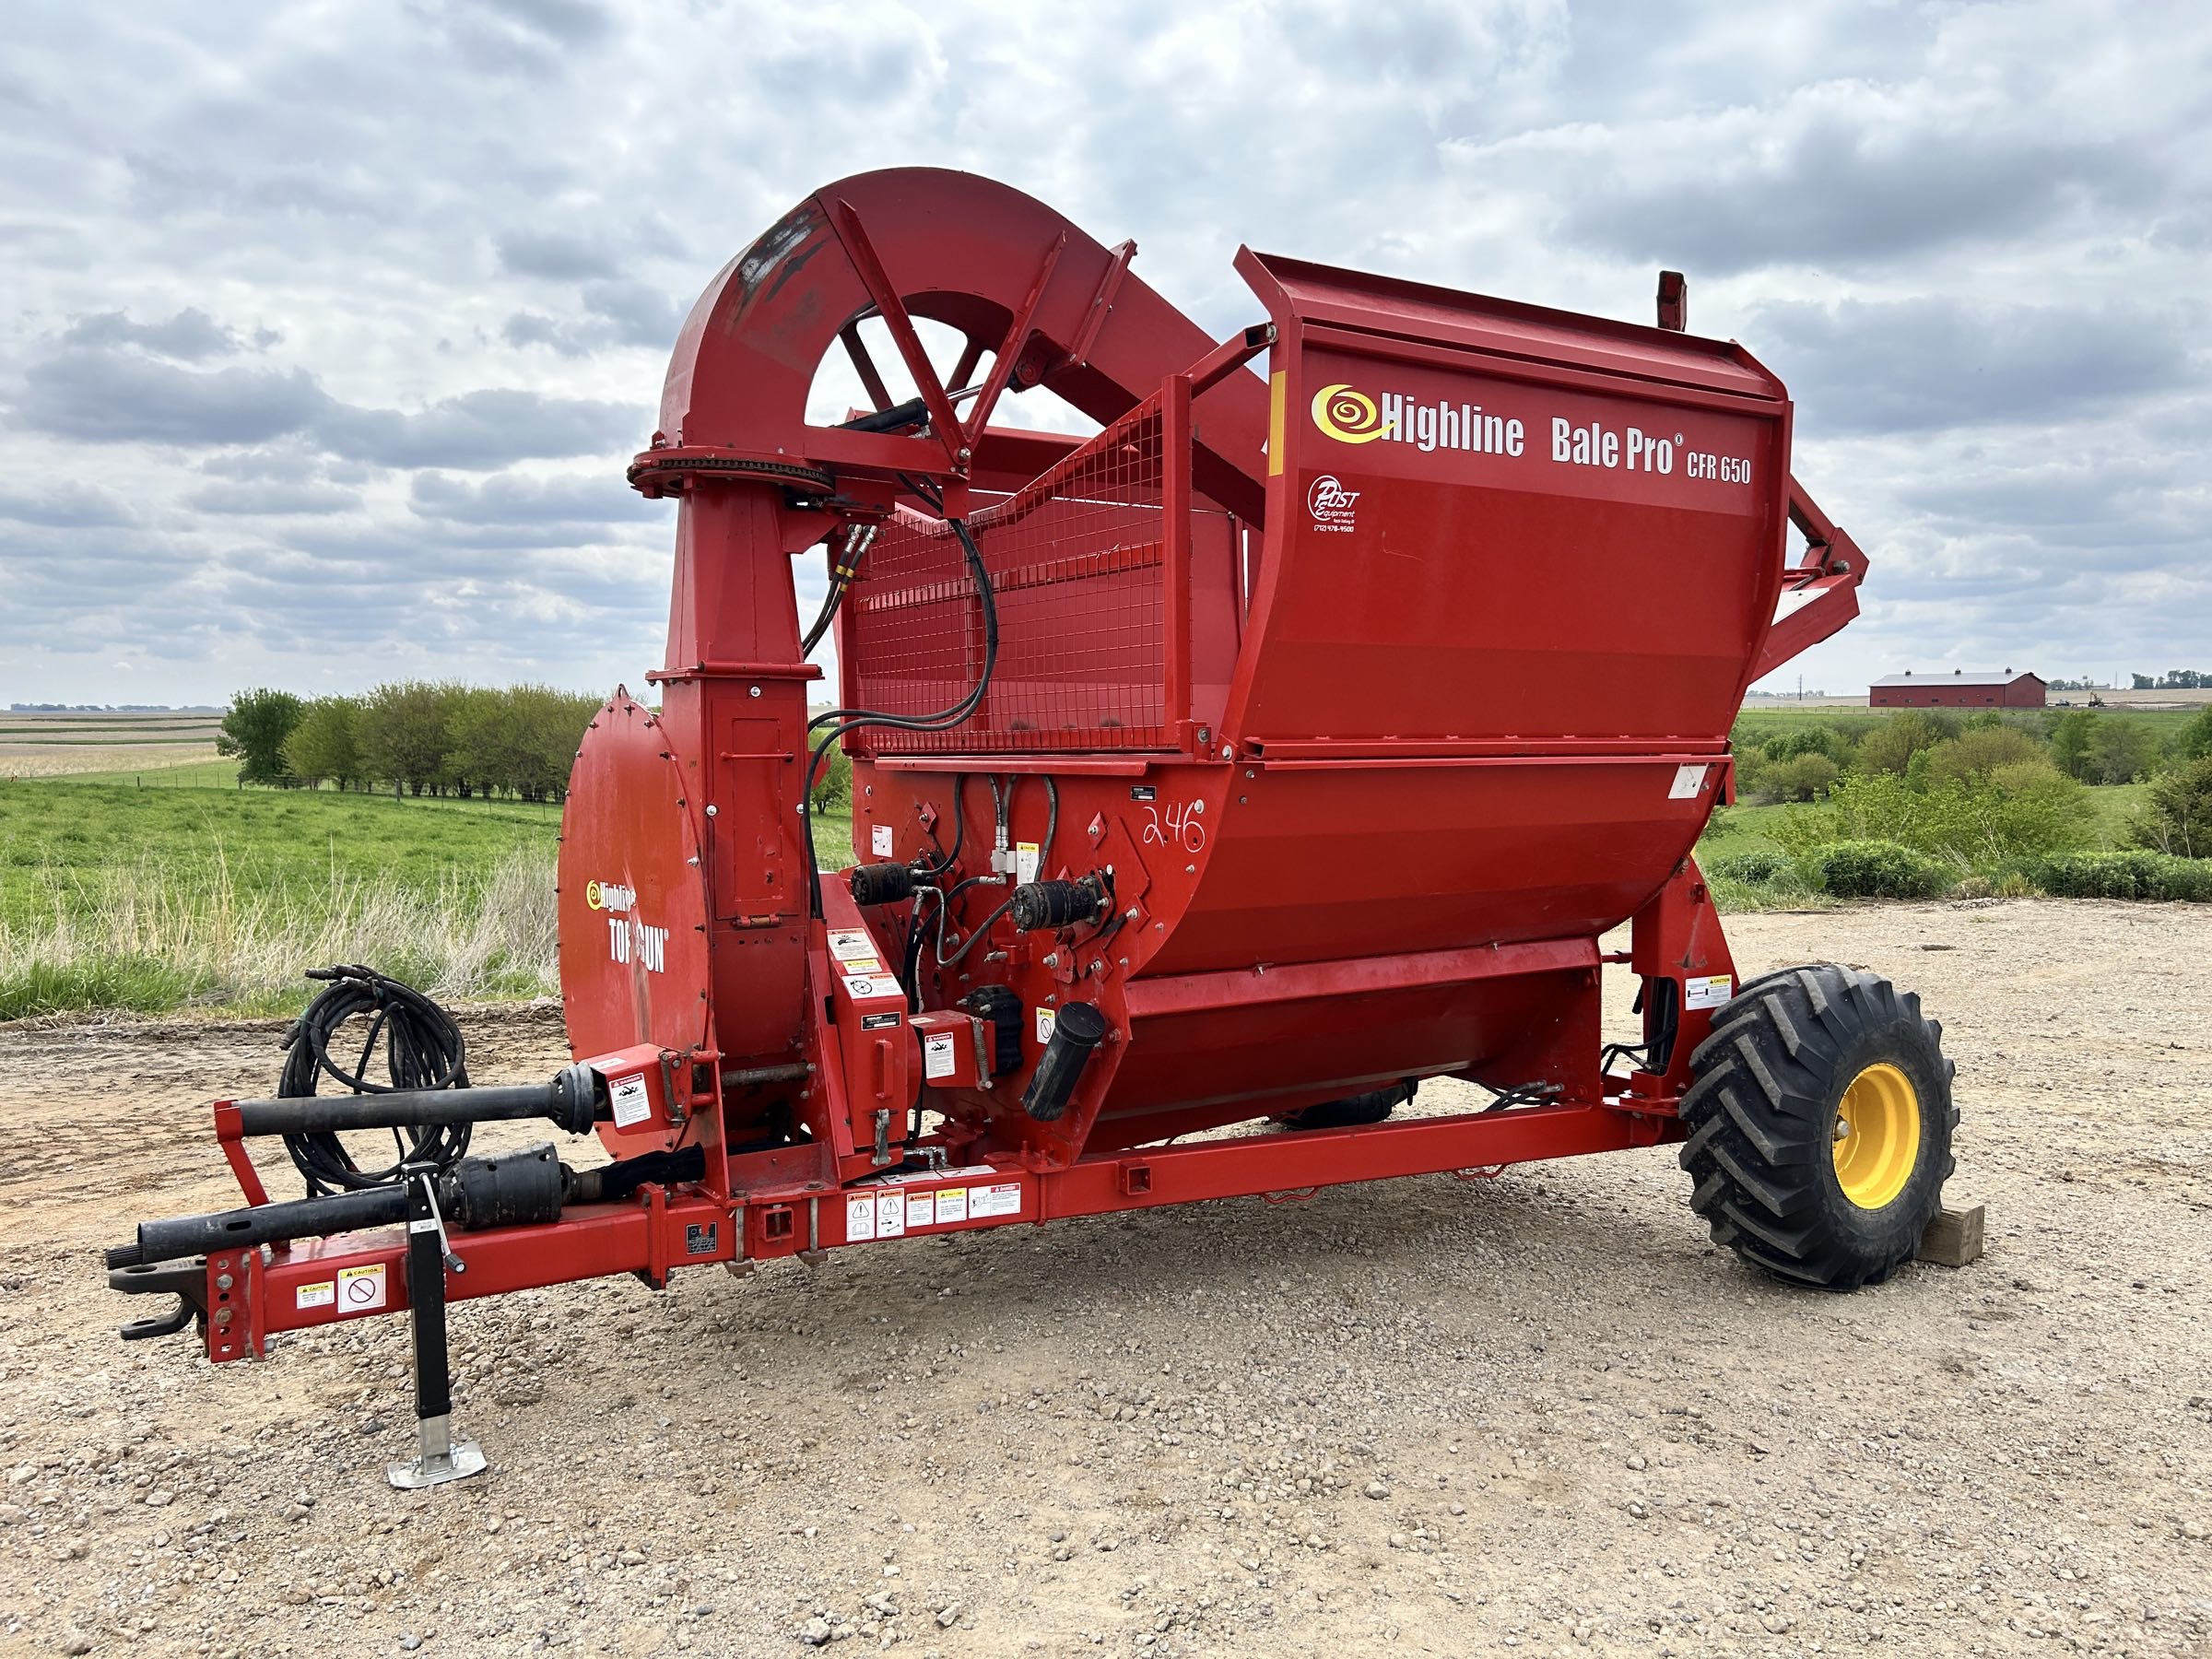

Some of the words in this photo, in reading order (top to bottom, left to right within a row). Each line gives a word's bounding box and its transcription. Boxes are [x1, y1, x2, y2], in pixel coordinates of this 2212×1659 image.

[1382, 392, 1524, 457] Highline
[1551, 417, 1619, 468] Bale
[1687, 452, 1717, 480] CFR
[1721, 456, 1751, 485] 650
[1315, 501, 1355, 518] Equipment
[354, 1267, 378, 1276] CAUTION
